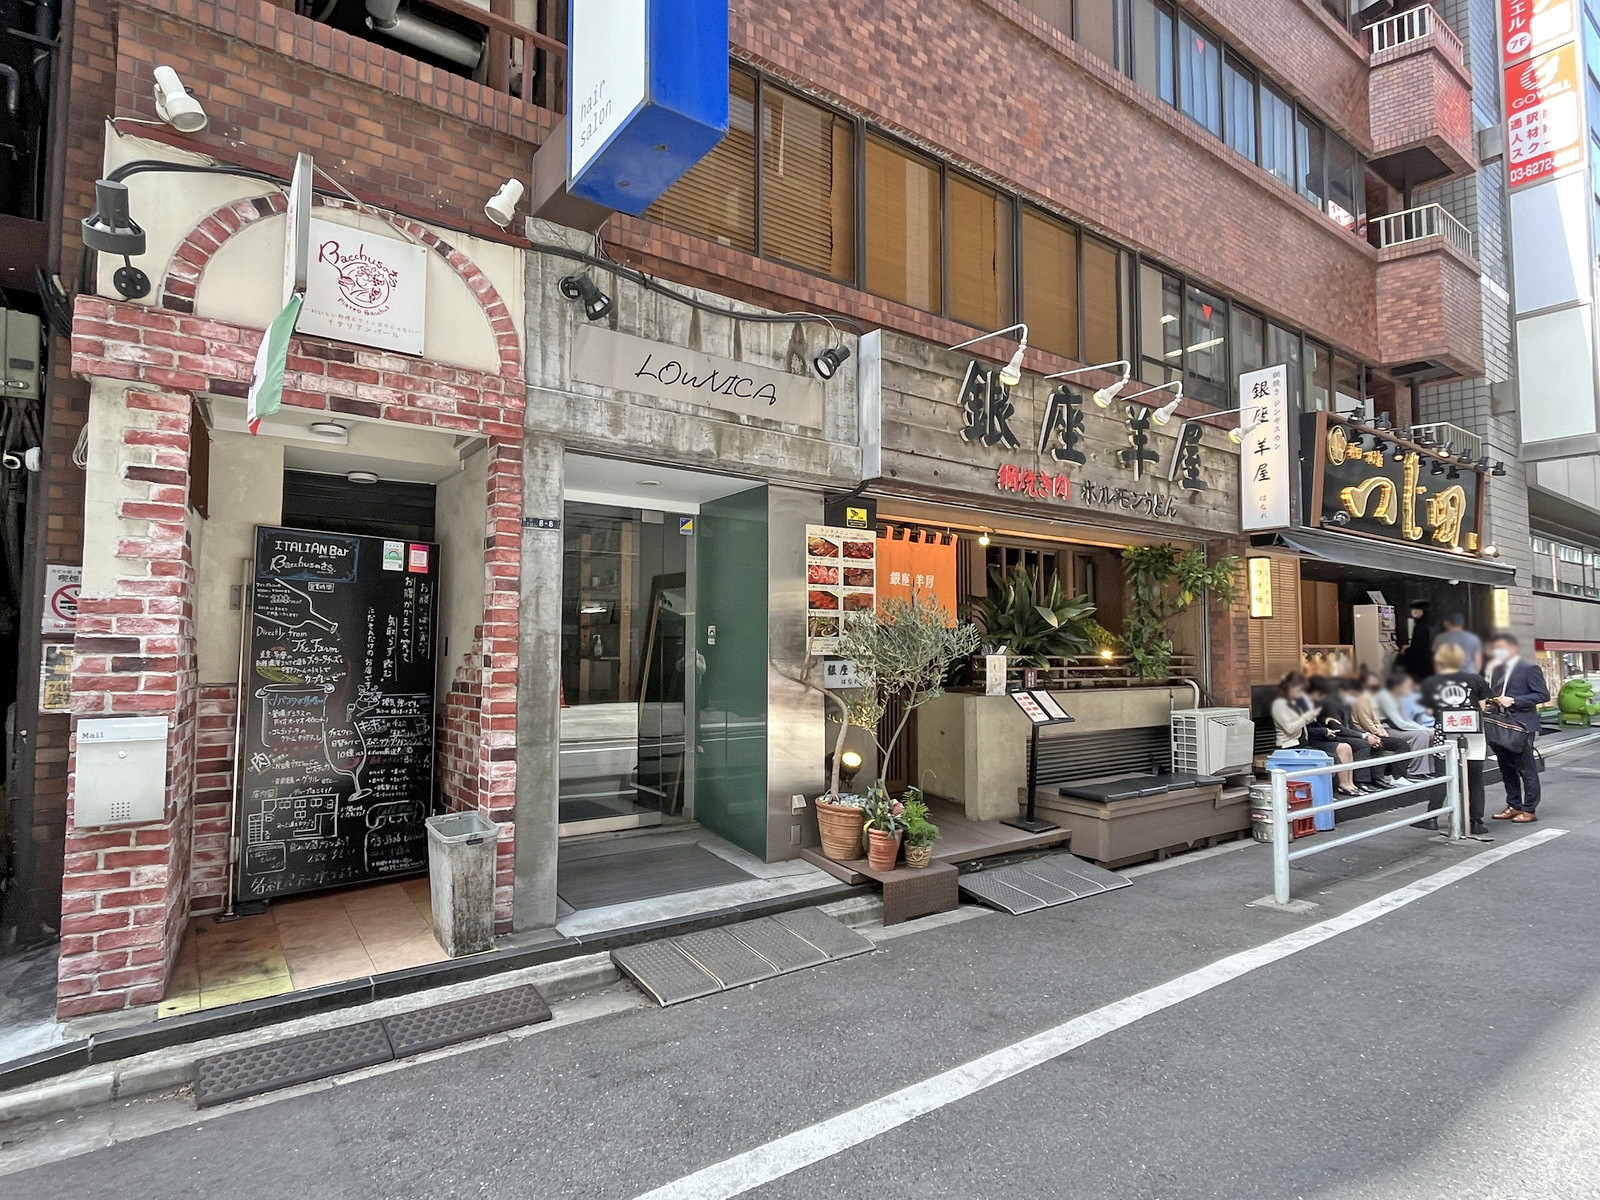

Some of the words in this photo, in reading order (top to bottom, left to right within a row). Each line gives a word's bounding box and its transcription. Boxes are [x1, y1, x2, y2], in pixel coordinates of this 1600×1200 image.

[1511, 36, 1527, 50] 7F
[581, 80, 605, 122] hair
[581, 100, 611, 147] salon
[957, 360, 1207, 492] 銀座羊屋
[1252, 380, 1271, 483] 銀座羊屋
[1273, 400, 1281, 450] ジンギスカン
[1081, 479, 1178, 519] ホルモンうどん
[538, 519, 554, 528] 8-8
[274, 540, 328, 555] ITALIAN
[329, 545, 349, 557] Bar
[890, 571, 935, 590] 銀座羊屋
[288, 627, 307, 637] from
[1446, 715, 1473, 727] 先頭
[82, 731, 104, 739] Mail
[251, 752, 271, 773] 肉
